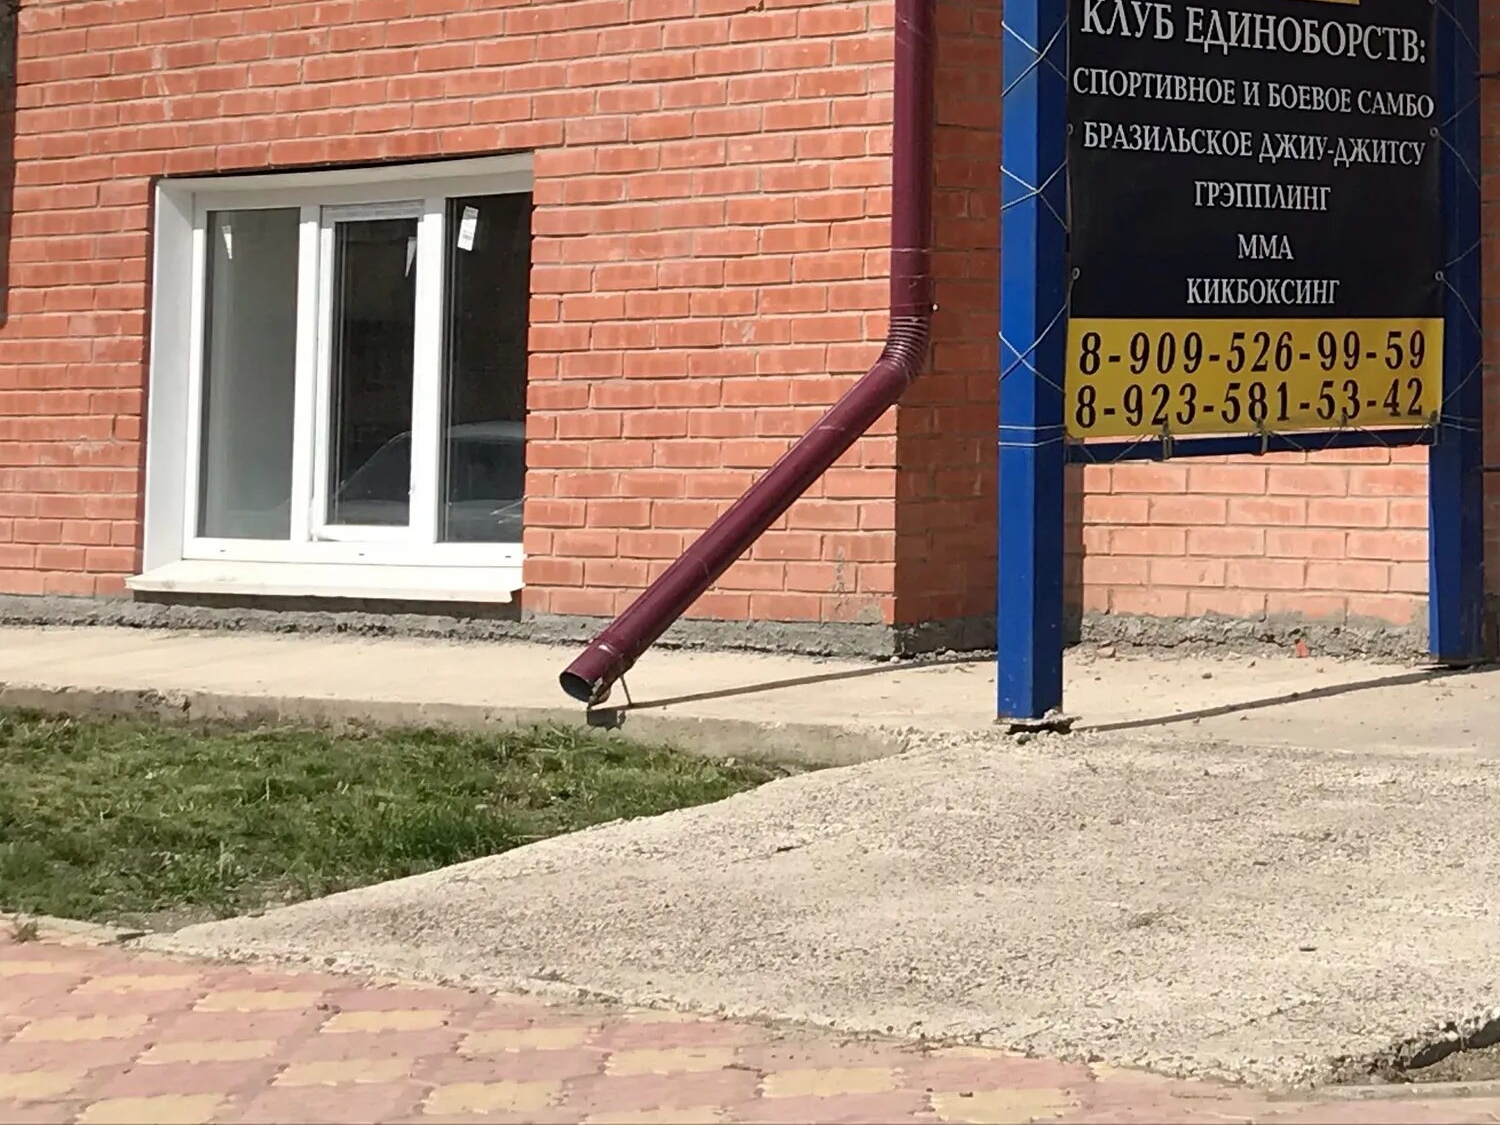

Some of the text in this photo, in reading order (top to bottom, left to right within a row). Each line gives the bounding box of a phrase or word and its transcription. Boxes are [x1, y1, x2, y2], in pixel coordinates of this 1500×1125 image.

[1185, 6, 1427, 65] ЕДИНОБОРСТВ:
[1072, 66, 1435, 119] СПОРТИВНОЕ И БОЕВОЕ САМБО
[1083, 121, 1426, 168] БРАЗИЛЬСКОЕ ДЖИУ-ДЖИТСУ
[1193, 181, 1331, 211] ГРЭППЛИНГ
[1237, 234, 1295, 261] ММА
[1186, 277, 1341, 305] КИКБОКСИНГ
[1078, 329, 1426, 375] 8-909-526-99-59
[1075, 377, 1424, 428] 8-923-581-53-42
